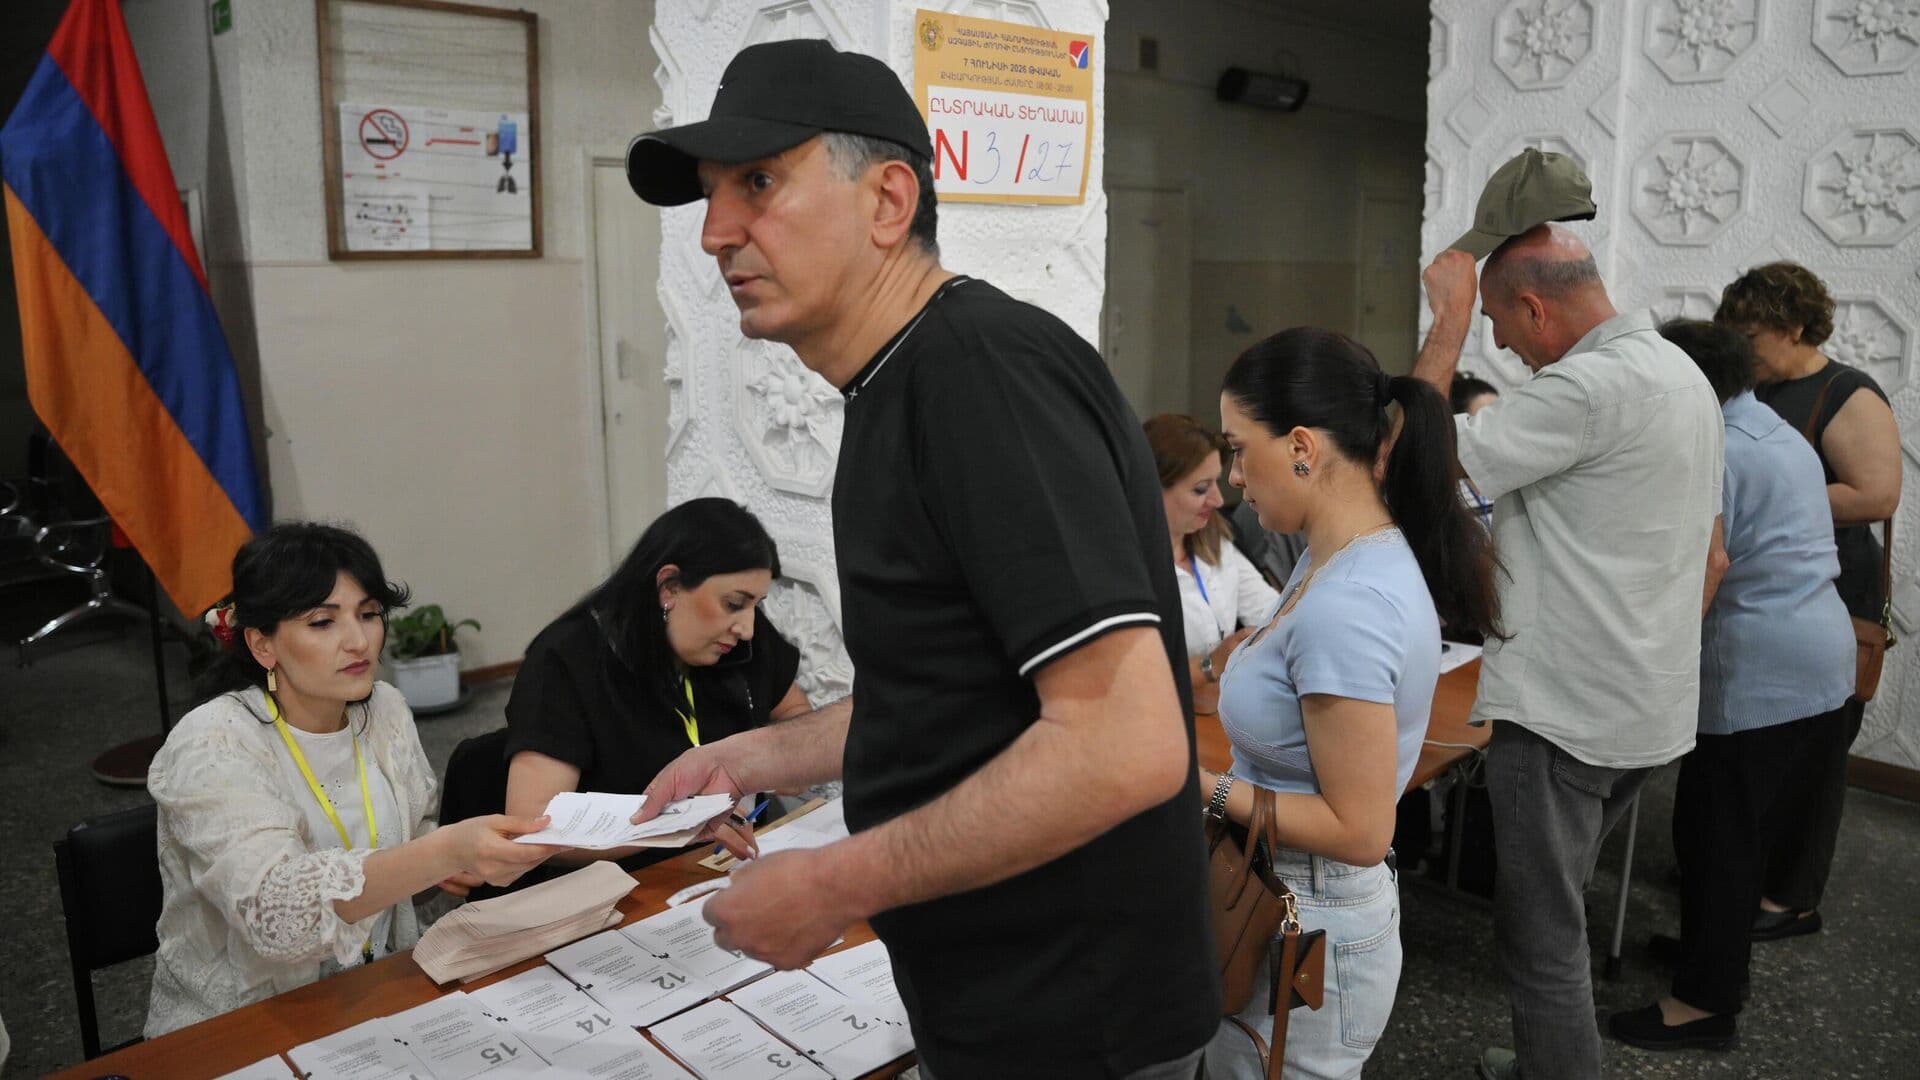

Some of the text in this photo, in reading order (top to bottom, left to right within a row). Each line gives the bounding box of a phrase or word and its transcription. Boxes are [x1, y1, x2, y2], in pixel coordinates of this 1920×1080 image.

[970, 58, 1008, 71] ՀՈՒՆԻՍԻ
[1010, 63, 1027, 73] 2026
[930, 97, 1084, 125] ԸՆՏՐԱԿԱՆ ՏԵՂԱՄԱՍ
[934, 128, 968, 181] N
[651, 971, 686, 990] 12
[575, 1013, 611, 1034] 14
[842, 1014, 868, 1030] 2
[480, 1042, 517, 1064] 15
[767, 1053, 791, 1069] 3
